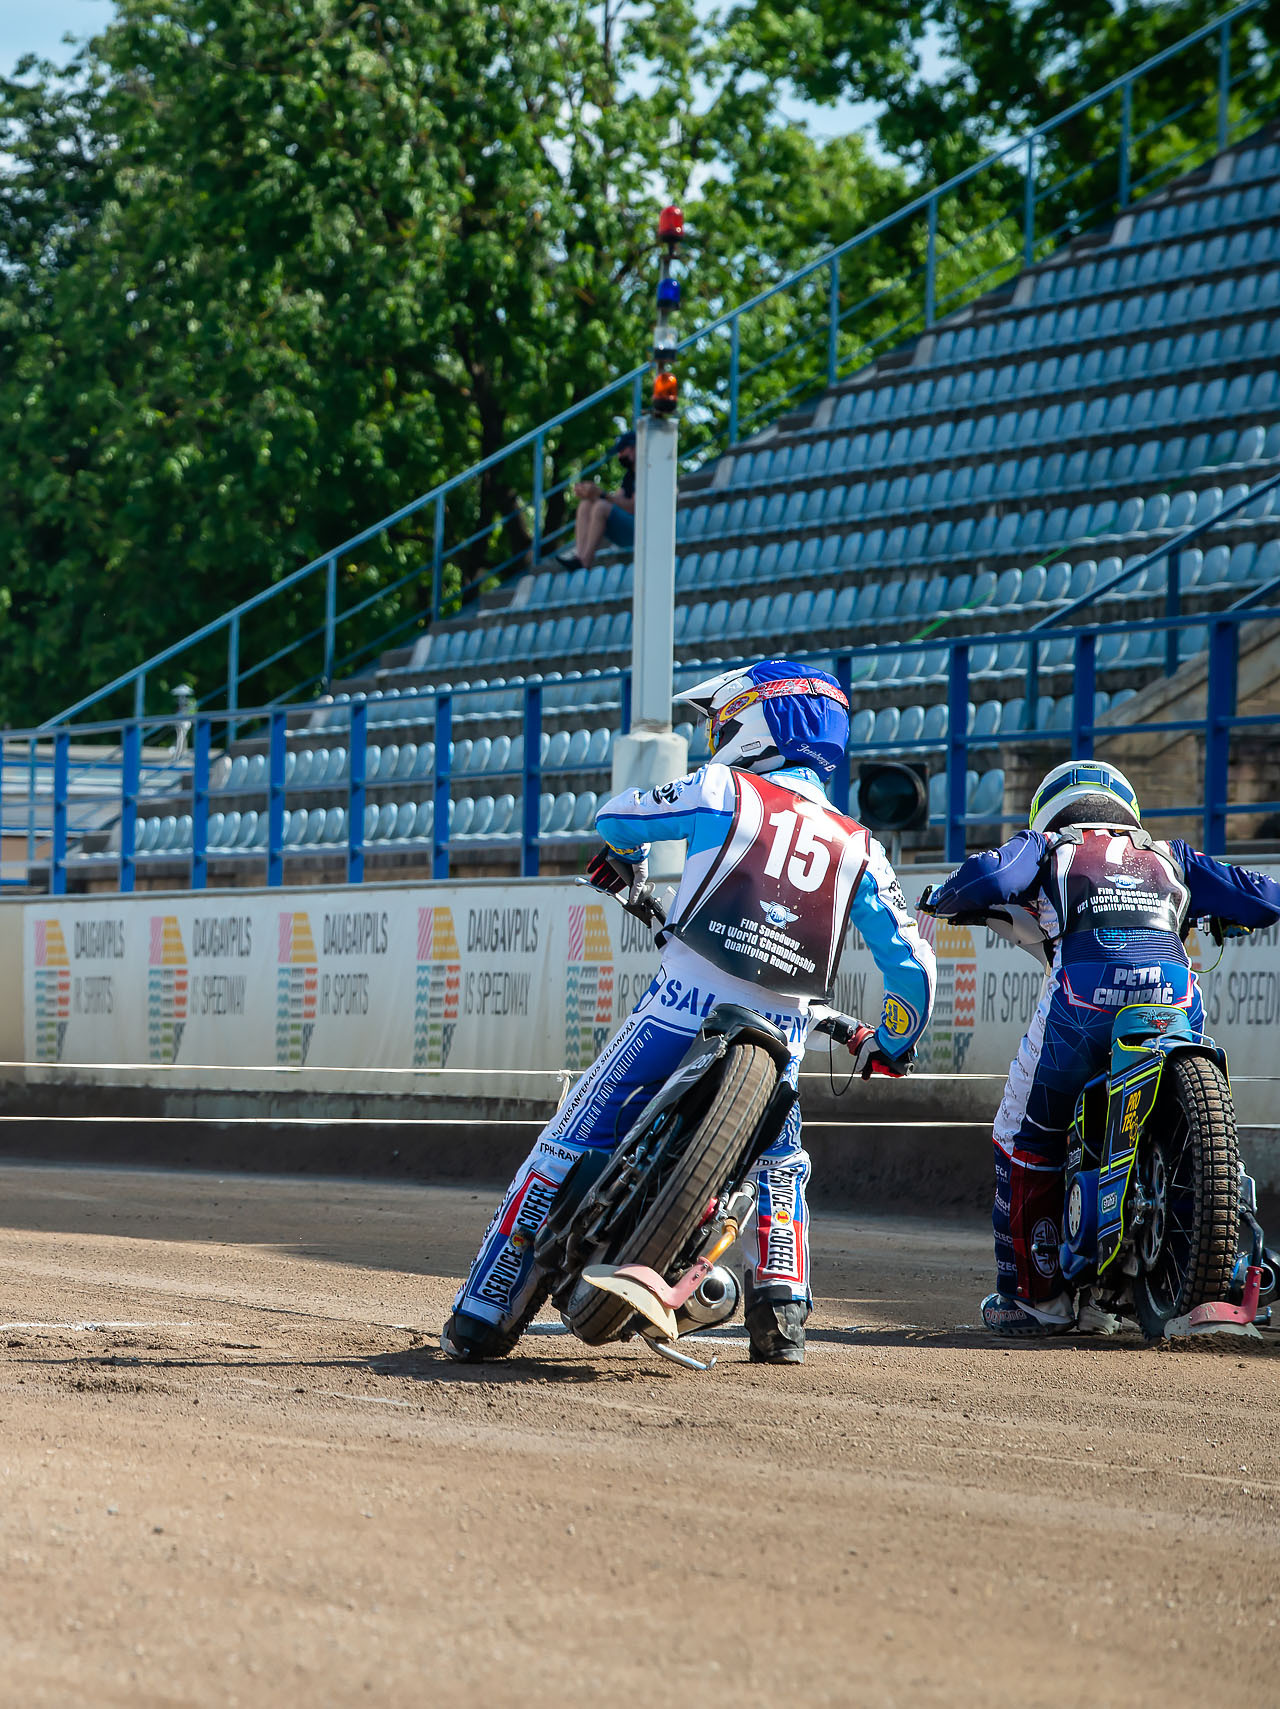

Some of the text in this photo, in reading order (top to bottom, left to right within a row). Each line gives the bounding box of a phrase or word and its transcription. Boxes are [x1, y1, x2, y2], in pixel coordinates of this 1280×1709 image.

[763, 809, 833, 893] 15
[1076, 899, 1089, 914] U21
[1090, 895, 1120, 906] World
[1092, 902, 1136, 914] Qualifying
[1097, 887, 1114, 896] FIM
[193, 916, 253, 957] DAUGAVPILS
[322, 911, 388, 955] DAUGAVPILS
[466, 908, 539, 953] DAUGAVPILS
[708, 920, 816, 974] U21 World Championship
[740, 917, 801, 951] FIM Speedway
[724, 938, 798, 977] Qualifying Round 1
[1113, 966, 1162, 986] PETR
[332, 972, 370, 1016] SPORTS
[476, 971, 532, 1016] SPEEDWAY
[981, 972, 997, 1022] IR
[1092, 982, 1174, 1006] CHLUPÁČ
[1227, 971, 1280, 1025] SPEED
[575, 1103, 602, 1141] SUOMEN
[595, 1037, 645, 1107] MOOTTORILIITTO
[1126, 1089, 1142, 1114] PRO
[768, 1167, 799, 1209] SERVICE
[481, 1246, 523, 1304] SERVICE
[516, 1183, 557, 1231] COFFEE
[767, 1226, 794, 1273] COFFEE
